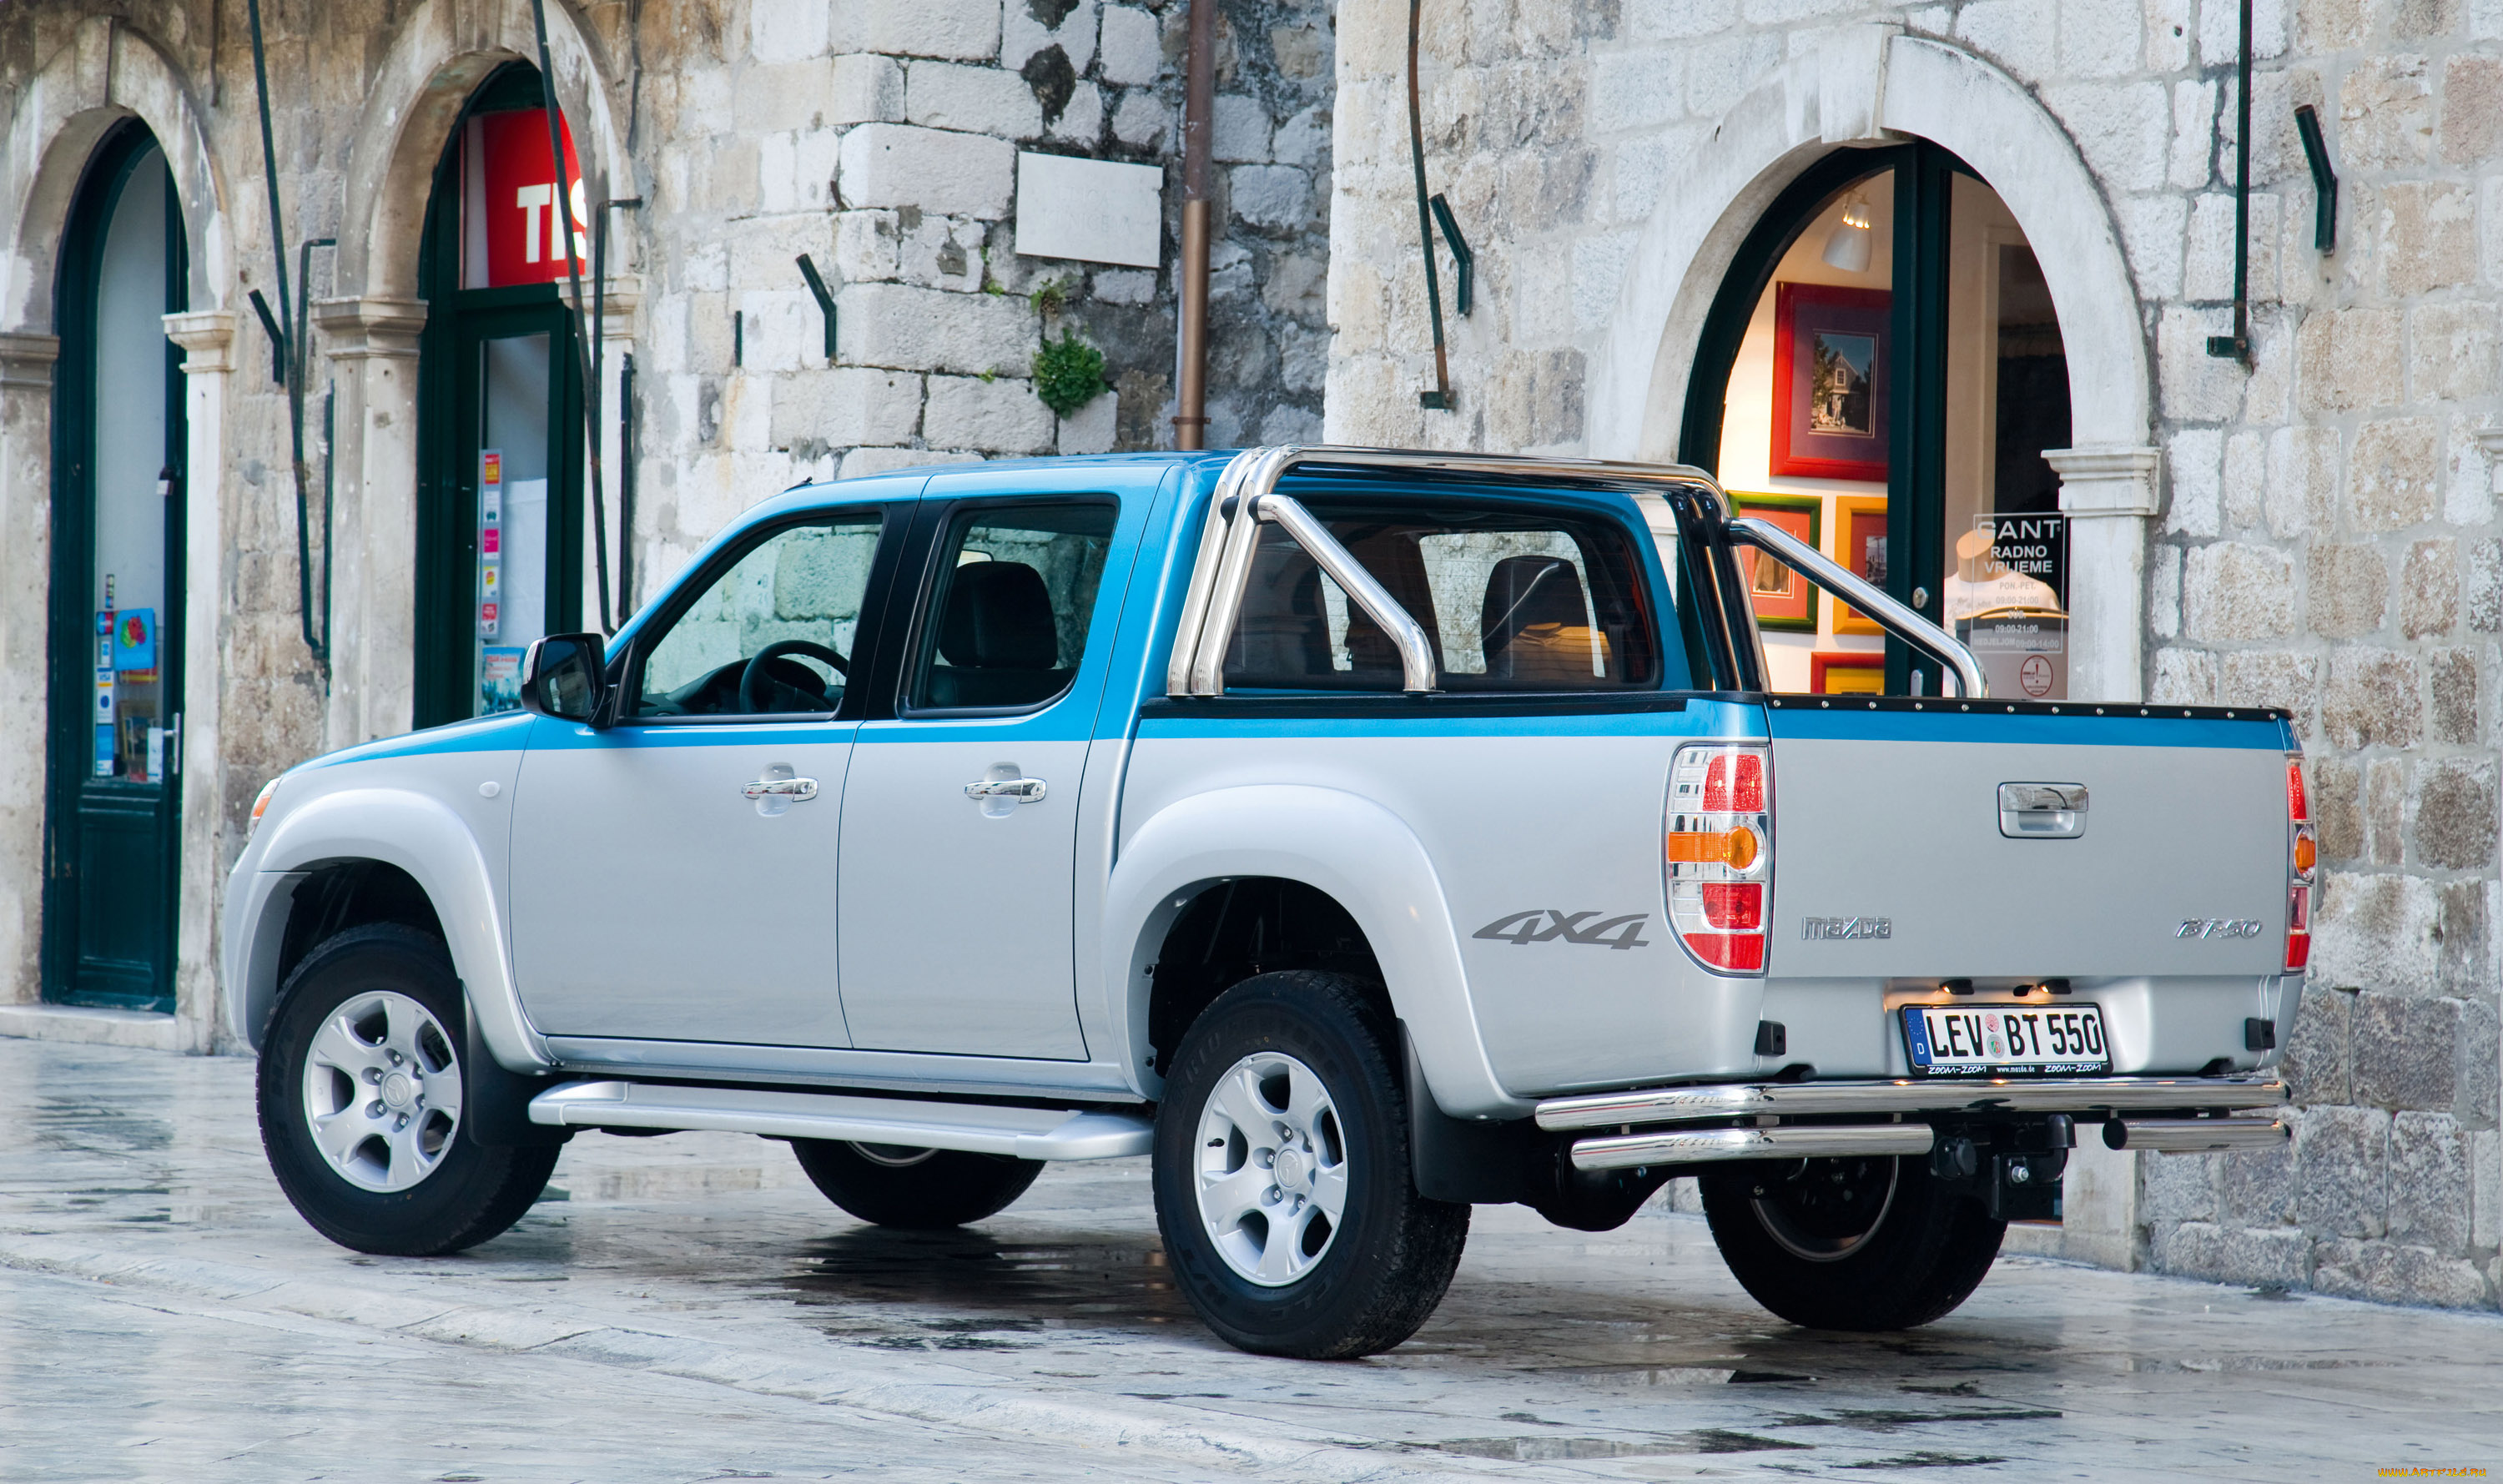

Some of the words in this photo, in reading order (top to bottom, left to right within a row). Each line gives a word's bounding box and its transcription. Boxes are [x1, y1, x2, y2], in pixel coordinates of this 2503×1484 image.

[1977, 520, 2061, 540] GANT
[1991, 545, 2047, 559] RADNO
[1984, 560, 2052, 574] VRIJEME
[1995, 596, 2039, 605] 09:00-21:00
[1995, 624, 2039, 634] 09:00-21:00
[2016, 639, 2060, 649] 09:00-14:00
[1926, 1014, 1983, 1057] LEV
[2003, 1013, 2040, 1056] BT
[2046, 1013, 2102, 1055] 550
[1916, 1043, 1925, 1054] D
